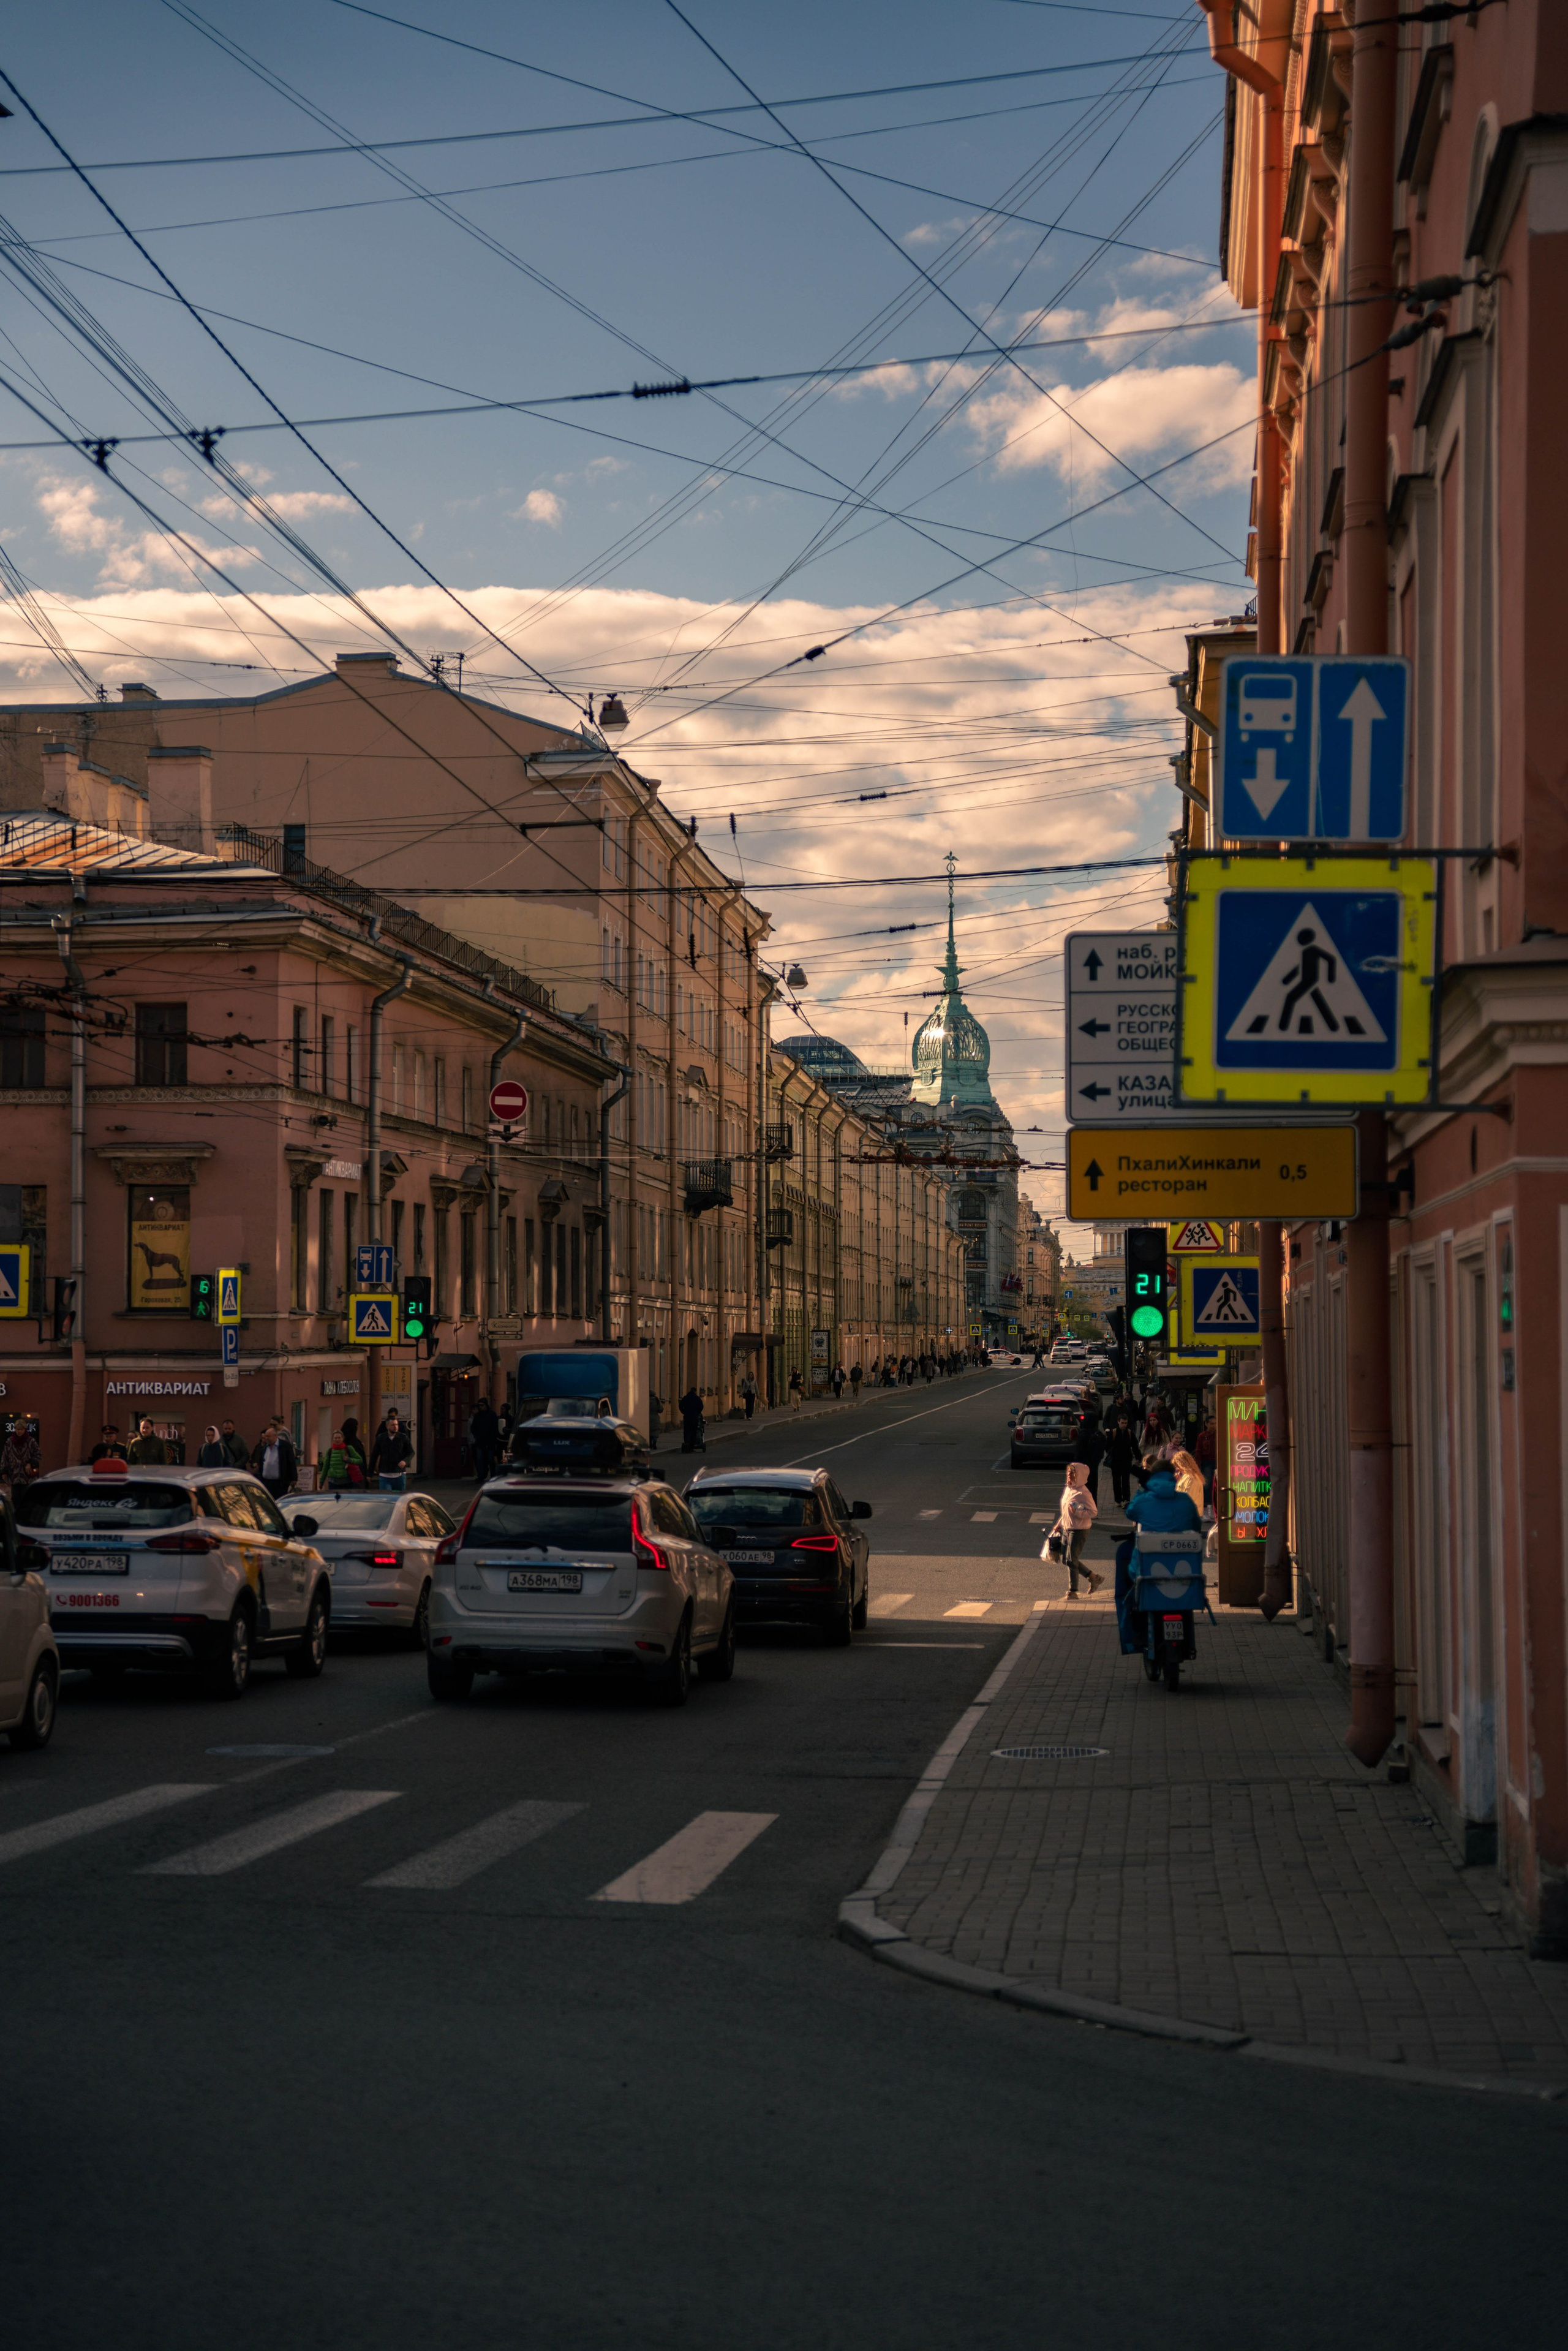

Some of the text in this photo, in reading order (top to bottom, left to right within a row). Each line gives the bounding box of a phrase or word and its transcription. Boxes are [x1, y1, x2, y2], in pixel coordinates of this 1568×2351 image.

[1118, 944, 1157, 959] наб.
[1118, 1076, 1172, 1090] КАЗА
[1118, 1155, 1307, 1182] ПхалиХинкали 0,5
[1118, 1179, 1207, 1194] ресторан
[1135, 1273, 1161, 1295] 21
[409, 1301, 423, 1315] 21
[106, 1381, 211, 1395] АНТИКВАРИАТ
[67, 1498, 138, 1508] Яндекс Go
[56, 1557, 123, 1569] У420РА 198
[512, 1574, 578, 1587] А368МА 198
[69, 1594, 119, 1607] 9001366
